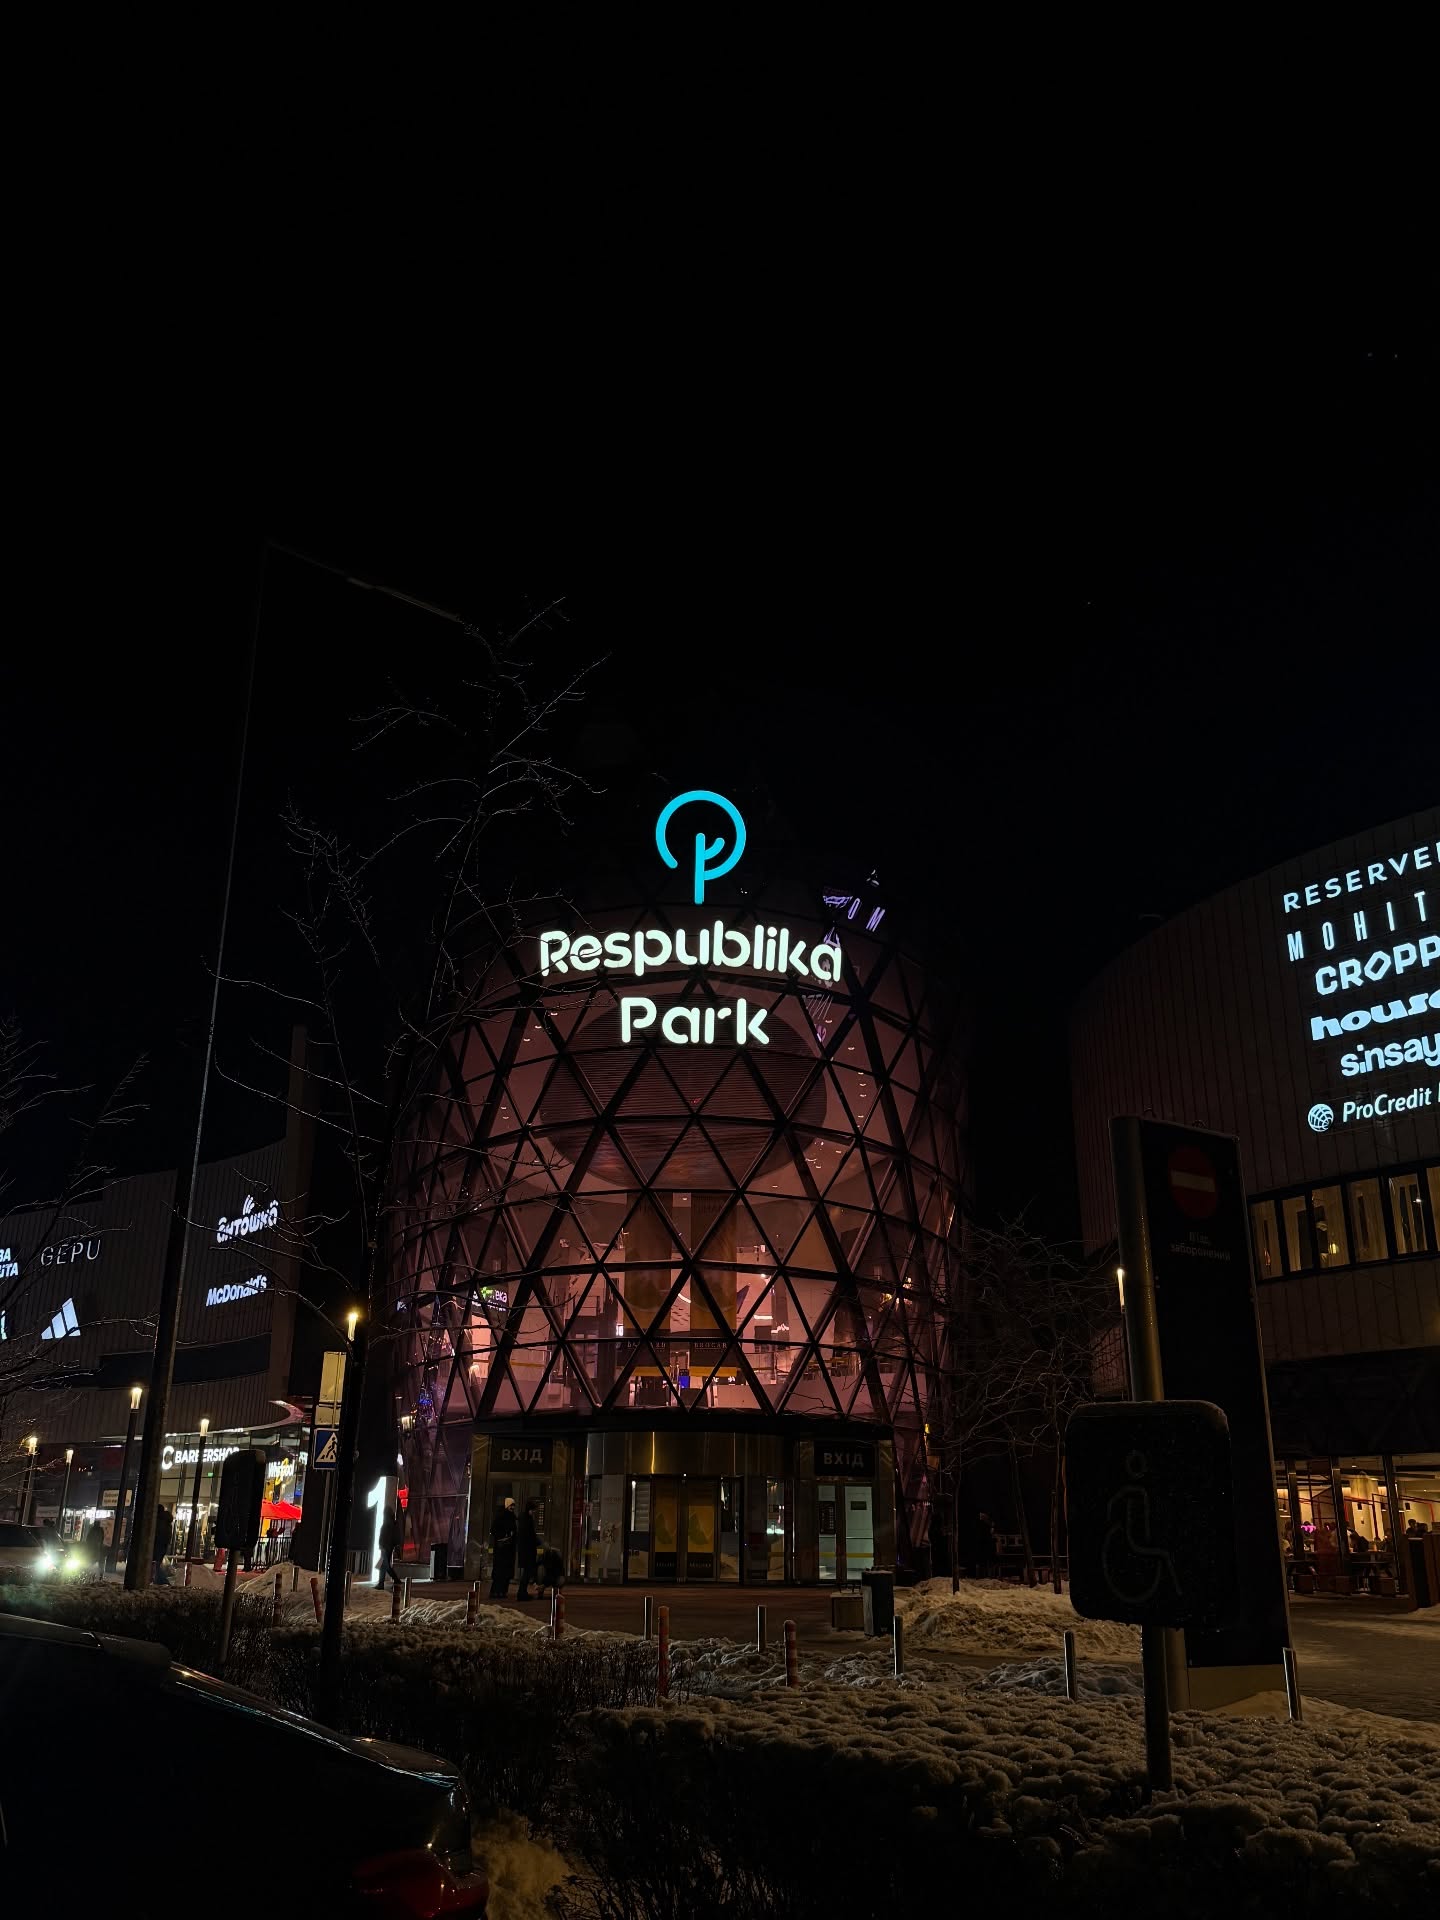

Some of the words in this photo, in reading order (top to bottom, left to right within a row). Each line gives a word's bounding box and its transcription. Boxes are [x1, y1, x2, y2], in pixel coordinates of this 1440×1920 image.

[1283, 841, 1440, 913] RESERVE
[540, 920, 842, 982] Respublika
[1315, 935, 1440, 996] CROPP
[621, 997, 770, 1045] Park
[1342, 1087, 1432, 1122] ProCredit
[40, 1239, 101, 1265] GEPU
[206, 1274, 268, 1306] McDonald's
[502, 1448, 543, 1464] ВХІД
[823, 1450, 865, 1469] ВХІД
